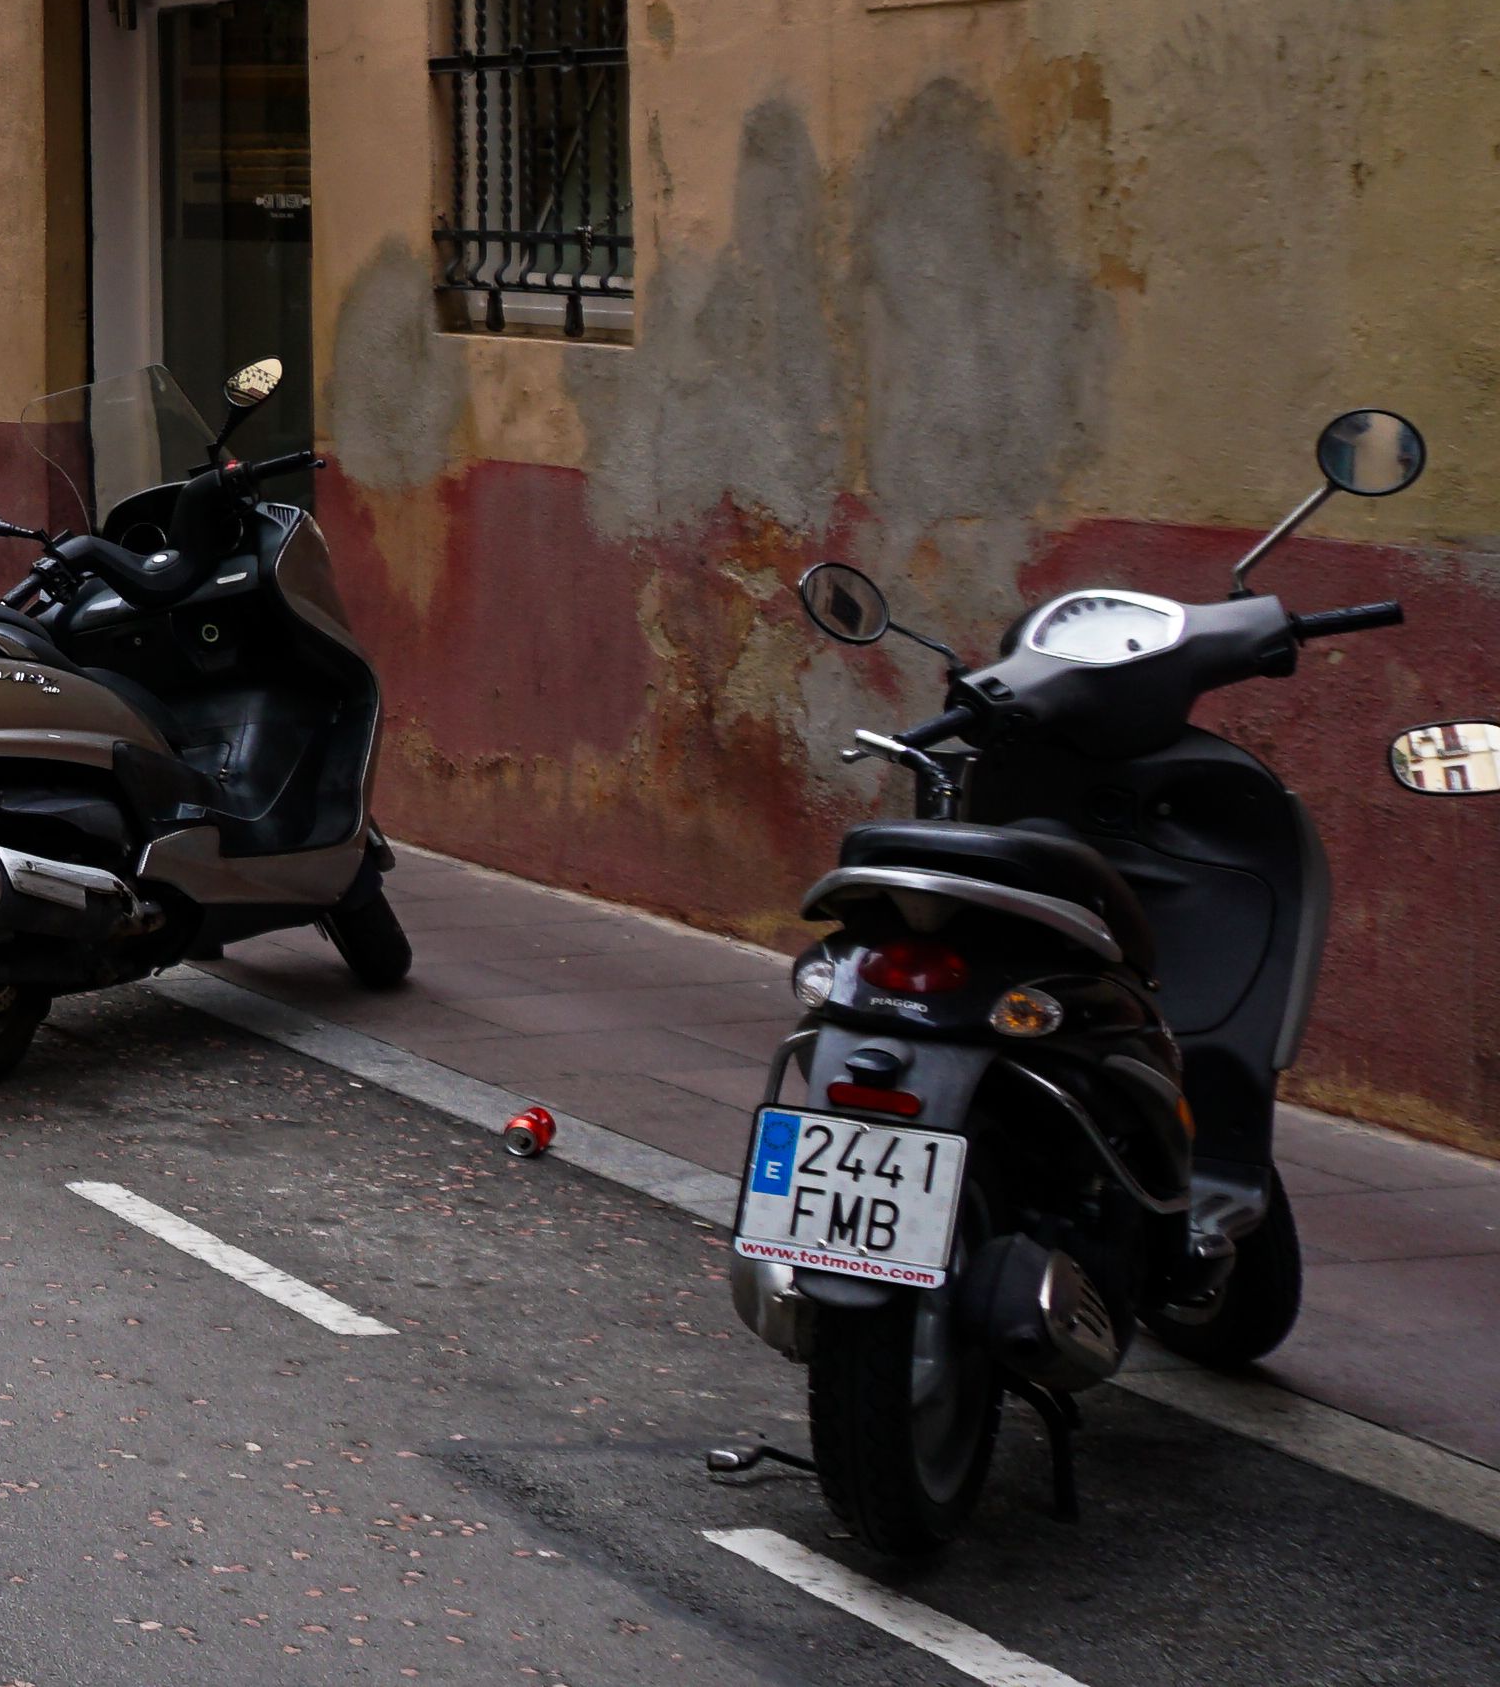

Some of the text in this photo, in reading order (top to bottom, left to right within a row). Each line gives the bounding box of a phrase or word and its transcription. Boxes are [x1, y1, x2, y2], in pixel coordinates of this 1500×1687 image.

[870, 997, 929, 1013] PIAGGIO
[764, 1160, 783, 1181] E
[798, 1124, 939, 1195] 2441
[789, 1185, 901, 1252] FMB
[740, 1240, 936, 1285] www.totmoto.com
